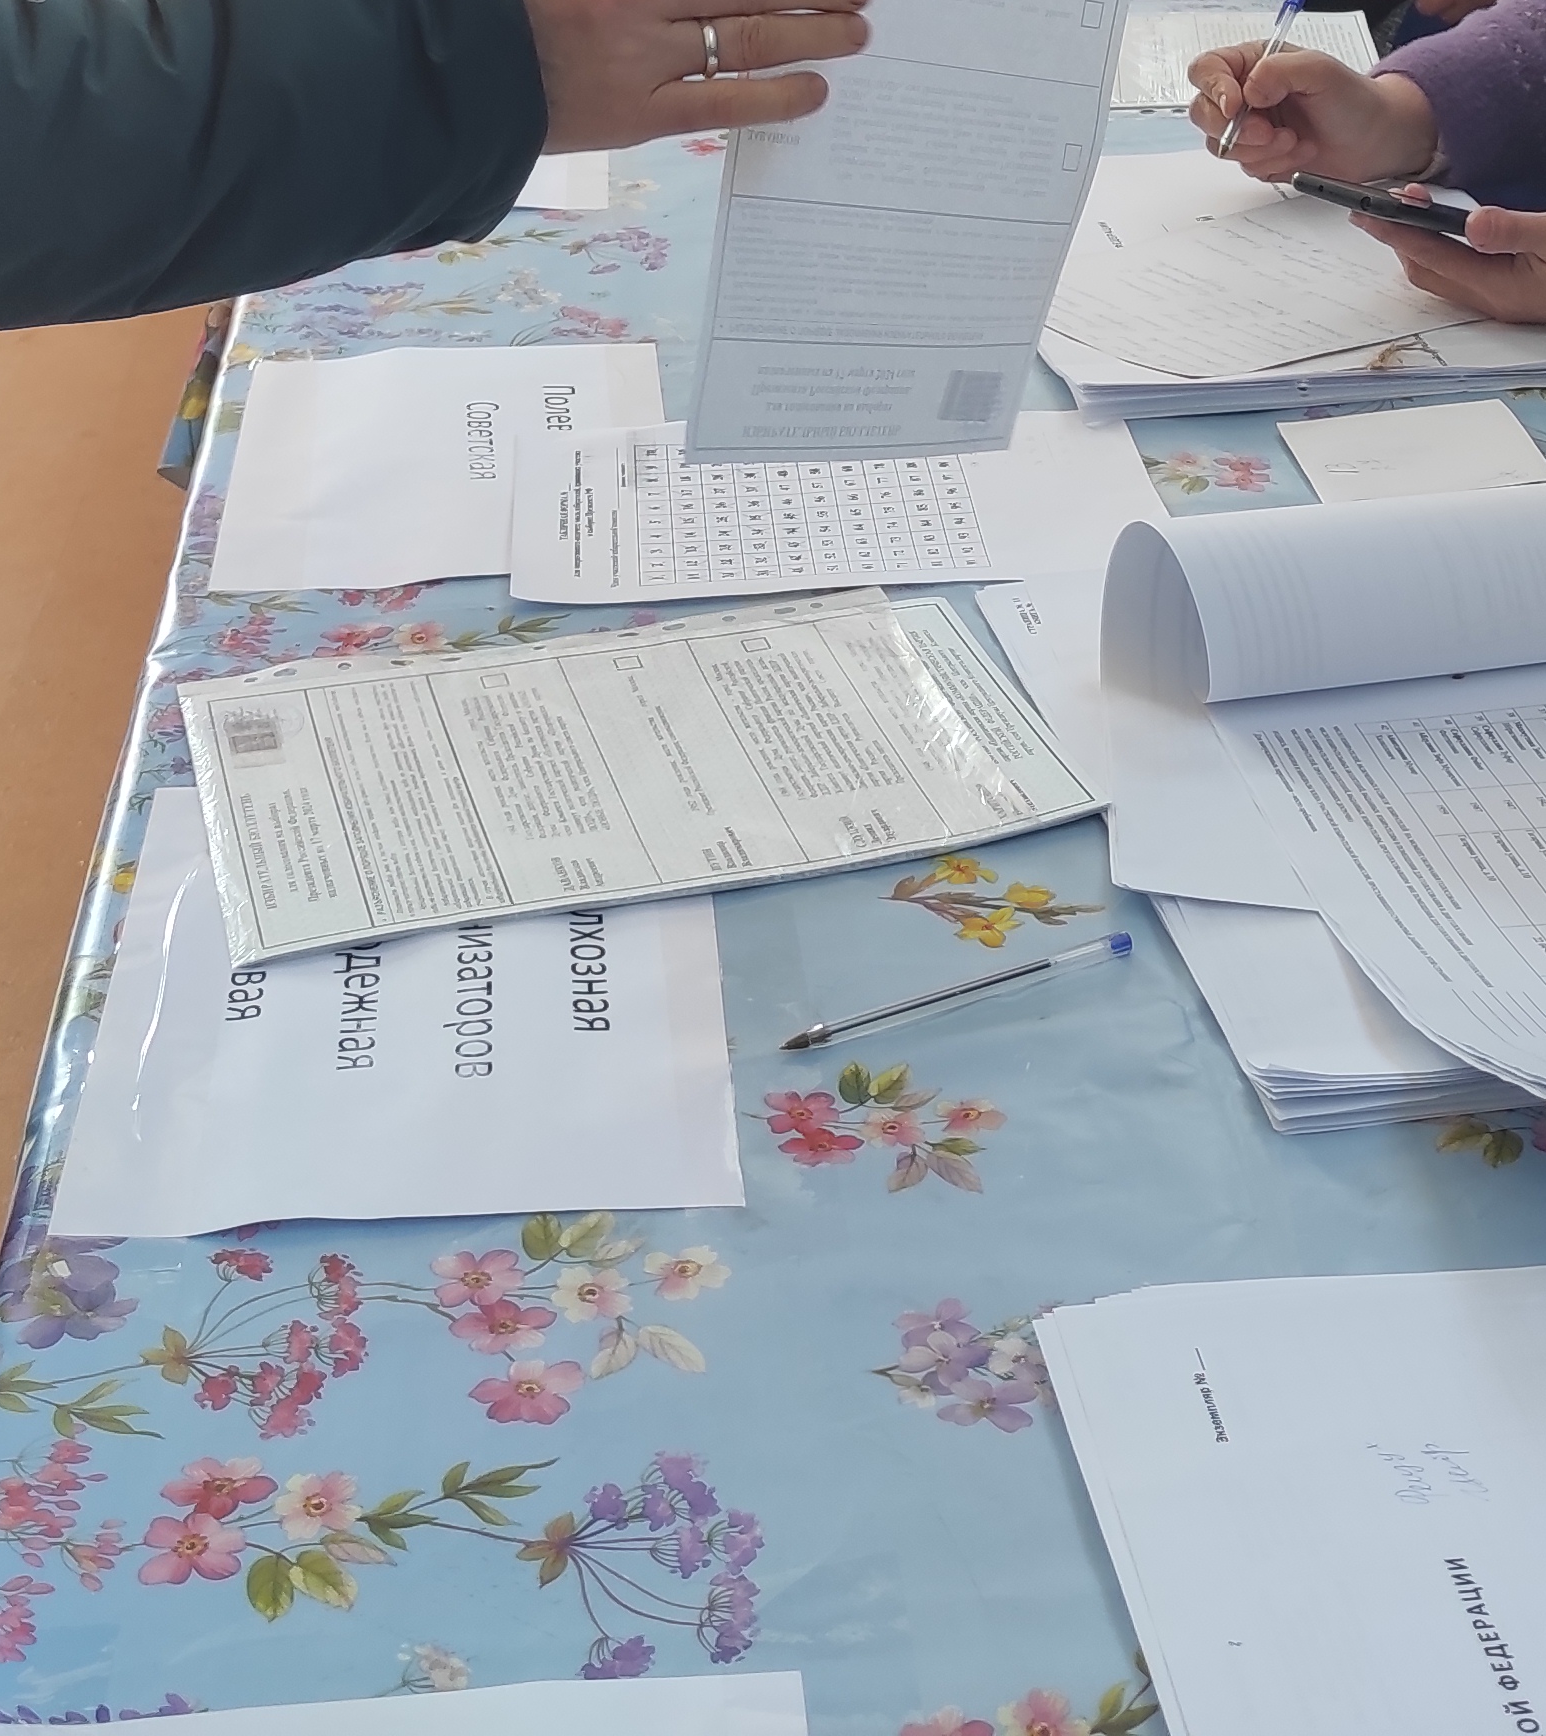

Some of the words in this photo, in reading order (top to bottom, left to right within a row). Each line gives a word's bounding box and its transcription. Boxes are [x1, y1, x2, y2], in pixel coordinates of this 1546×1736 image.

[465, 402, 500, 480] Советская
[225, 970, 267, 1022] вая
[1200, 1387, 1229, 1444] Экземпляр
[1443, 1557, 1521, 1692] ФЕДЕРАЦИИ
[1502, 1700, 1545, 1736] ОЙ
